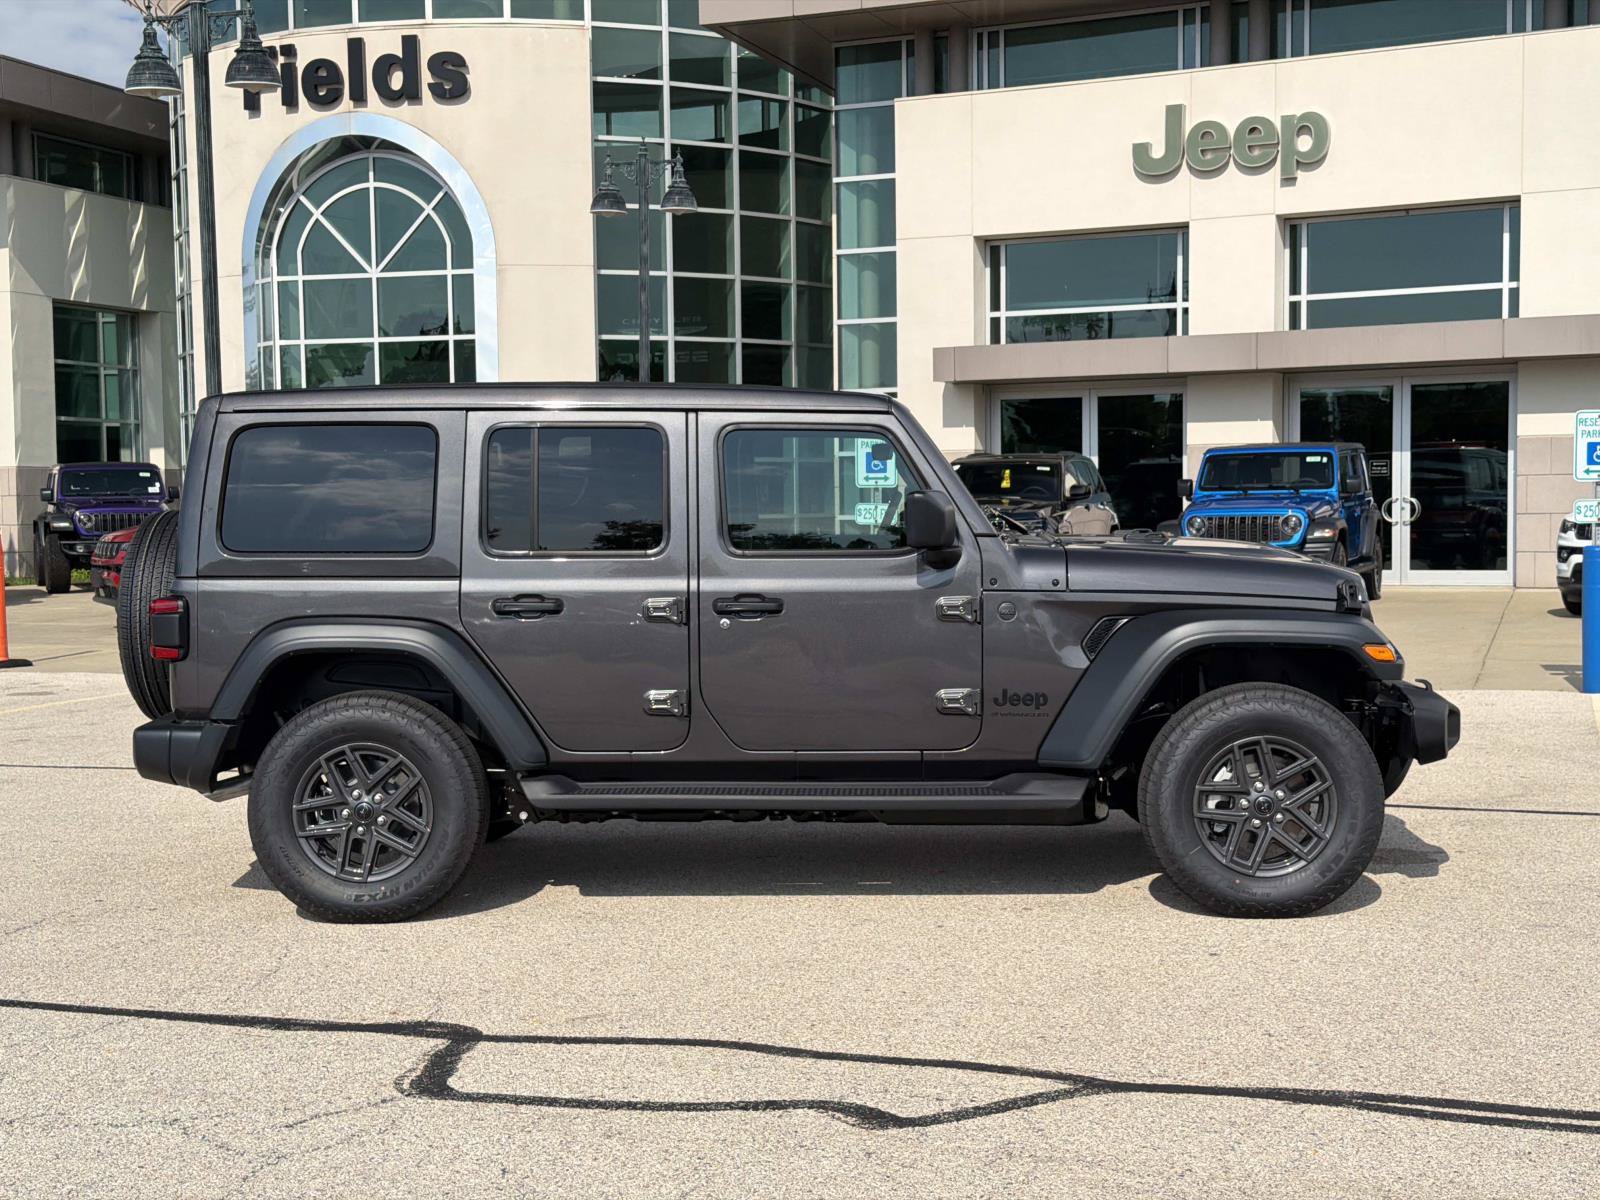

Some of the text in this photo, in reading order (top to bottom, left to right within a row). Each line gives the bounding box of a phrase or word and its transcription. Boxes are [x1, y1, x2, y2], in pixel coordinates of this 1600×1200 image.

[243, 34, 470, 112] ields
[1132, 103, 1331, 179] Jeep
[992, 688, 1049, 710] Jeep
